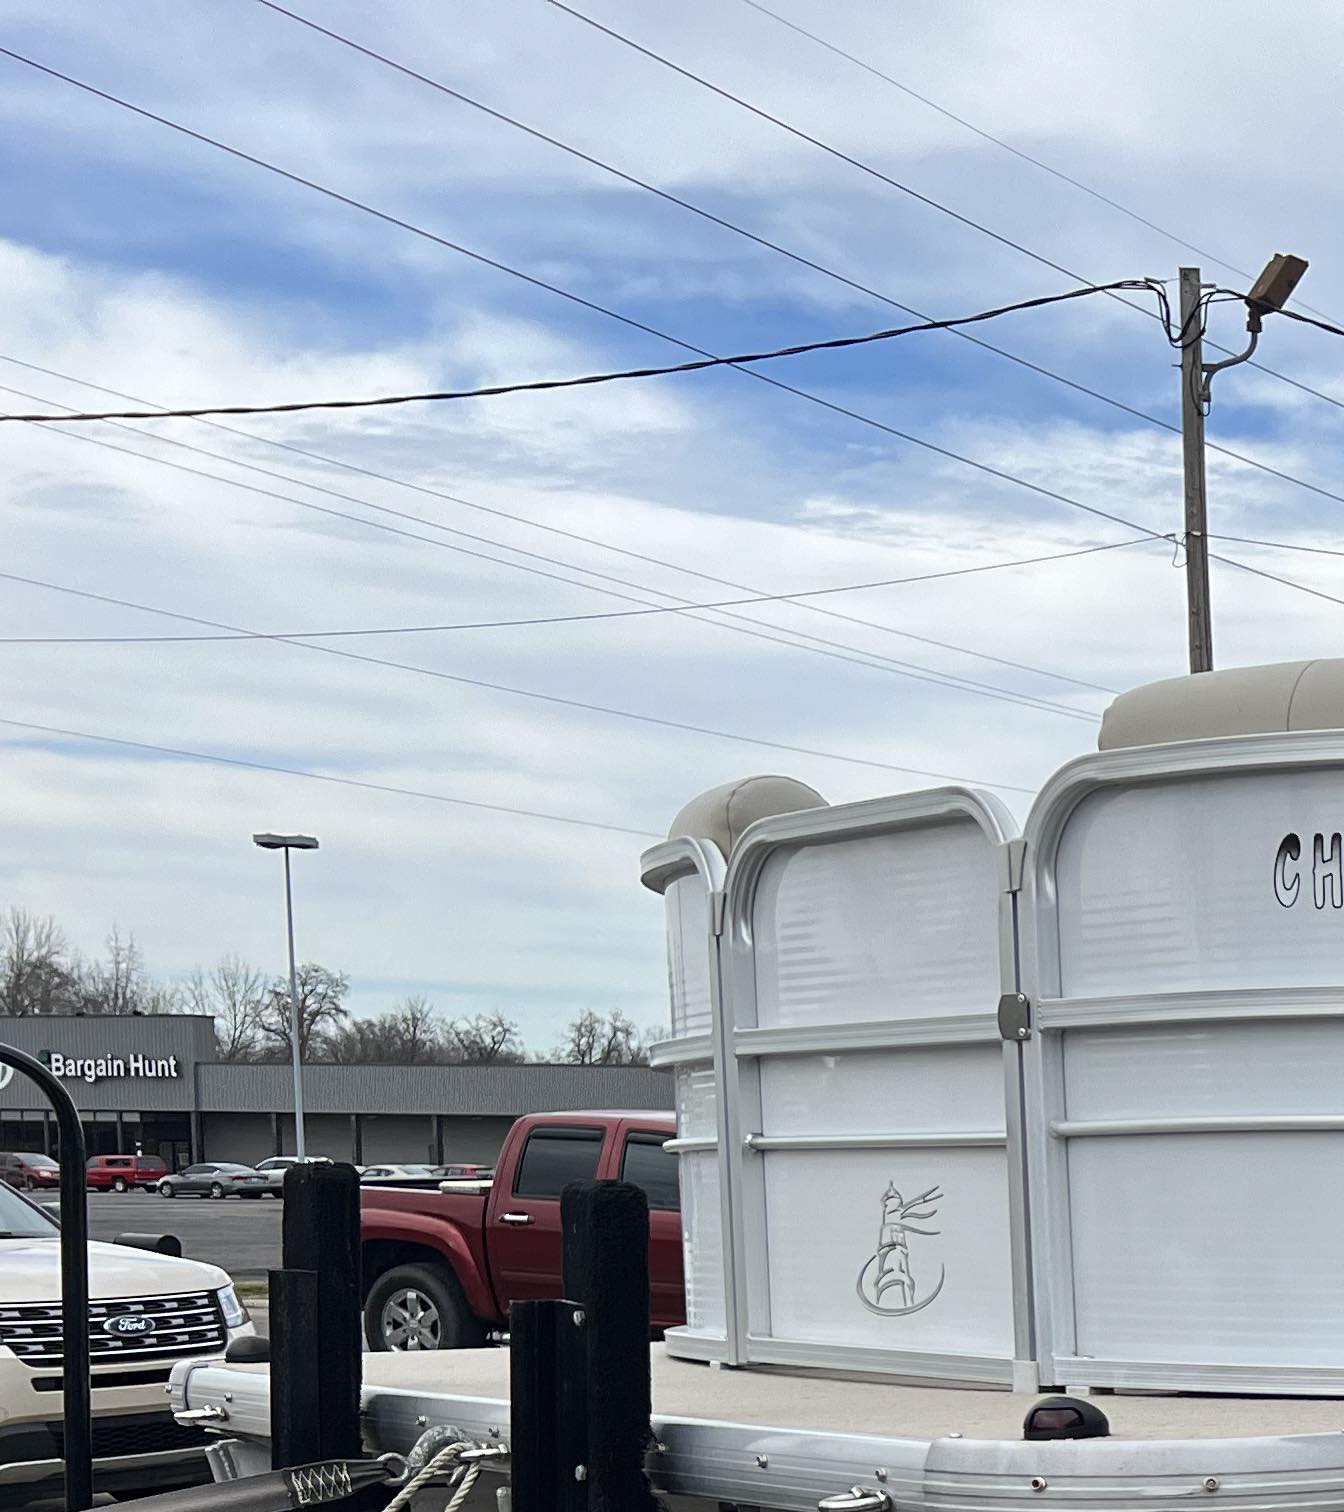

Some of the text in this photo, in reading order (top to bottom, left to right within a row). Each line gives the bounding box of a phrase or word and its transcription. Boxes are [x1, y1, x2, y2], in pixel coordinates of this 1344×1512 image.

[50, 1053, 178, 1083] Bargain Hunt
[118, 1317, 147, 1331] Ford
